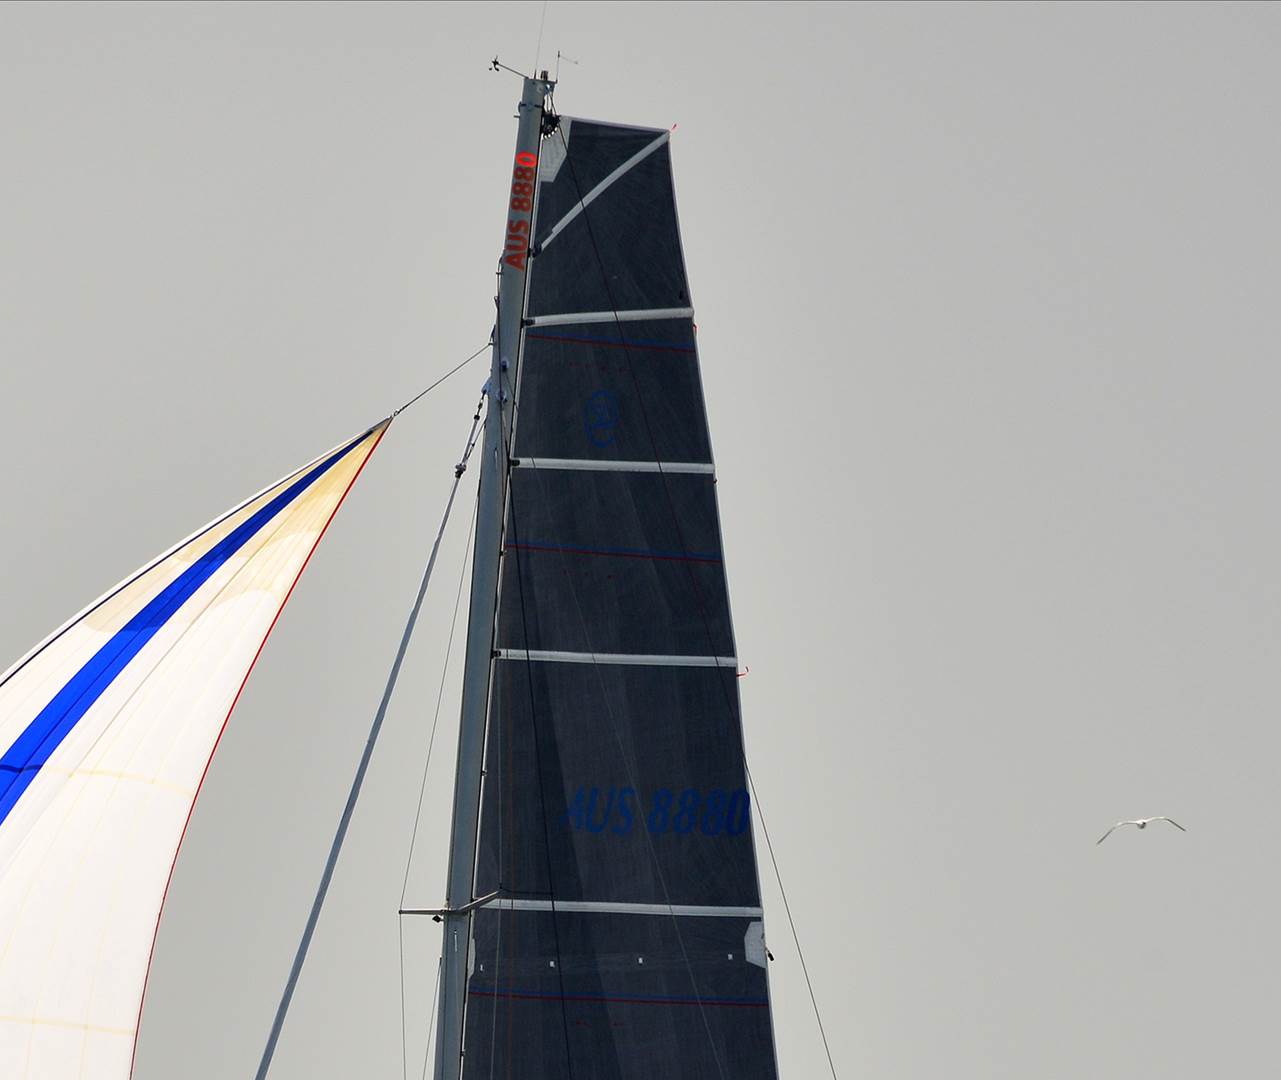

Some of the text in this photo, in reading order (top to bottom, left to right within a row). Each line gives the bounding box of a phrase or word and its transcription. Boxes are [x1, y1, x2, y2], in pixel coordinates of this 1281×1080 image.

[503, 151, 538, 272] AUS 8880
[560, 784, 751, 838] AUS 8880
